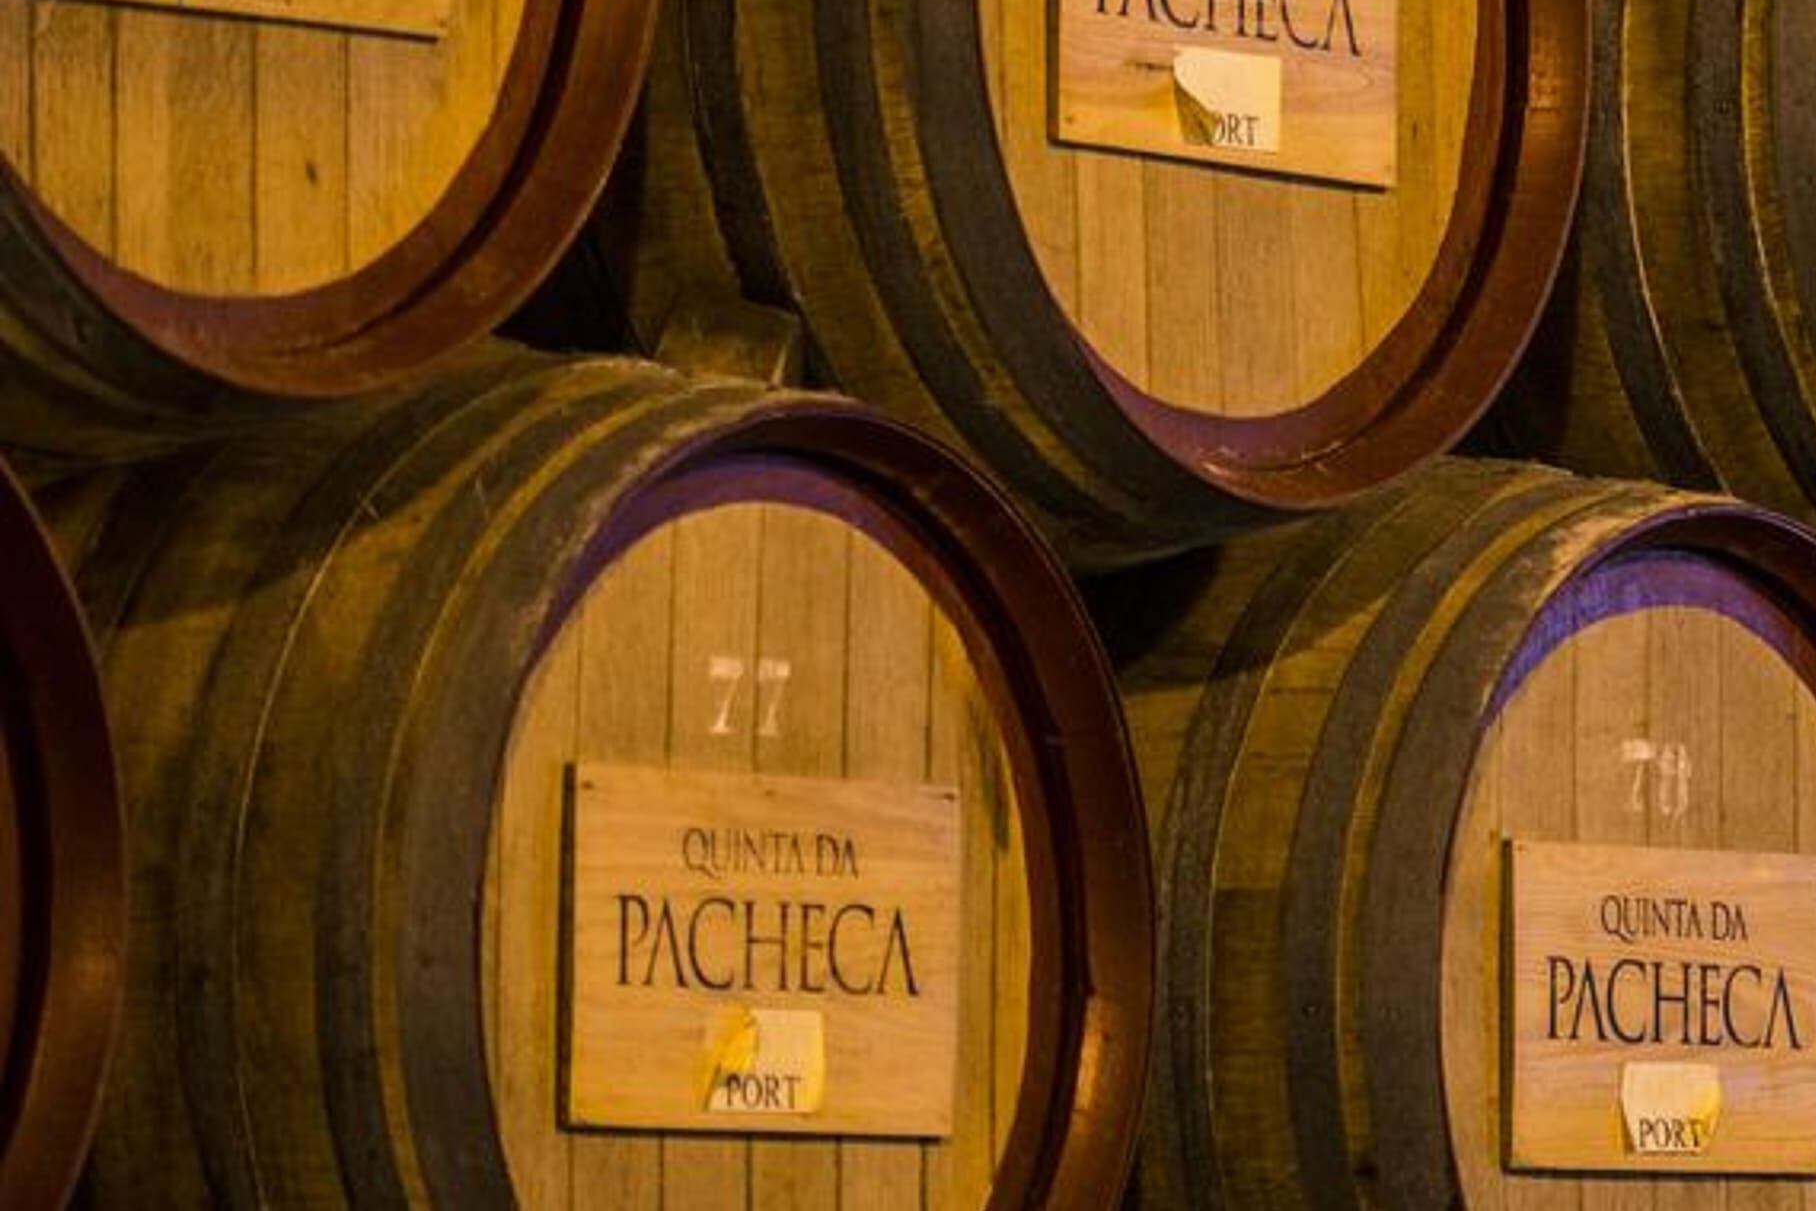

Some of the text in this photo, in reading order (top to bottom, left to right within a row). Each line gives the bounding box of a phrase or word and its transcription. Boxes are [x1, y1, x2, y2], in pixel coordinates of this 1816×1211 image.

[707, 655, 792, 738] 77
[681, 825, 860, 881] QUINTA DA
[615, 894, 921, 997] PACHECA
[1599, 894, 1749, 943] QUINTA DA
[1546, 955, 1803, 1051] PACHECA
[724, 1072, 802, 1110] PORT
[1638, 1117, 1706, 1149] PORT
